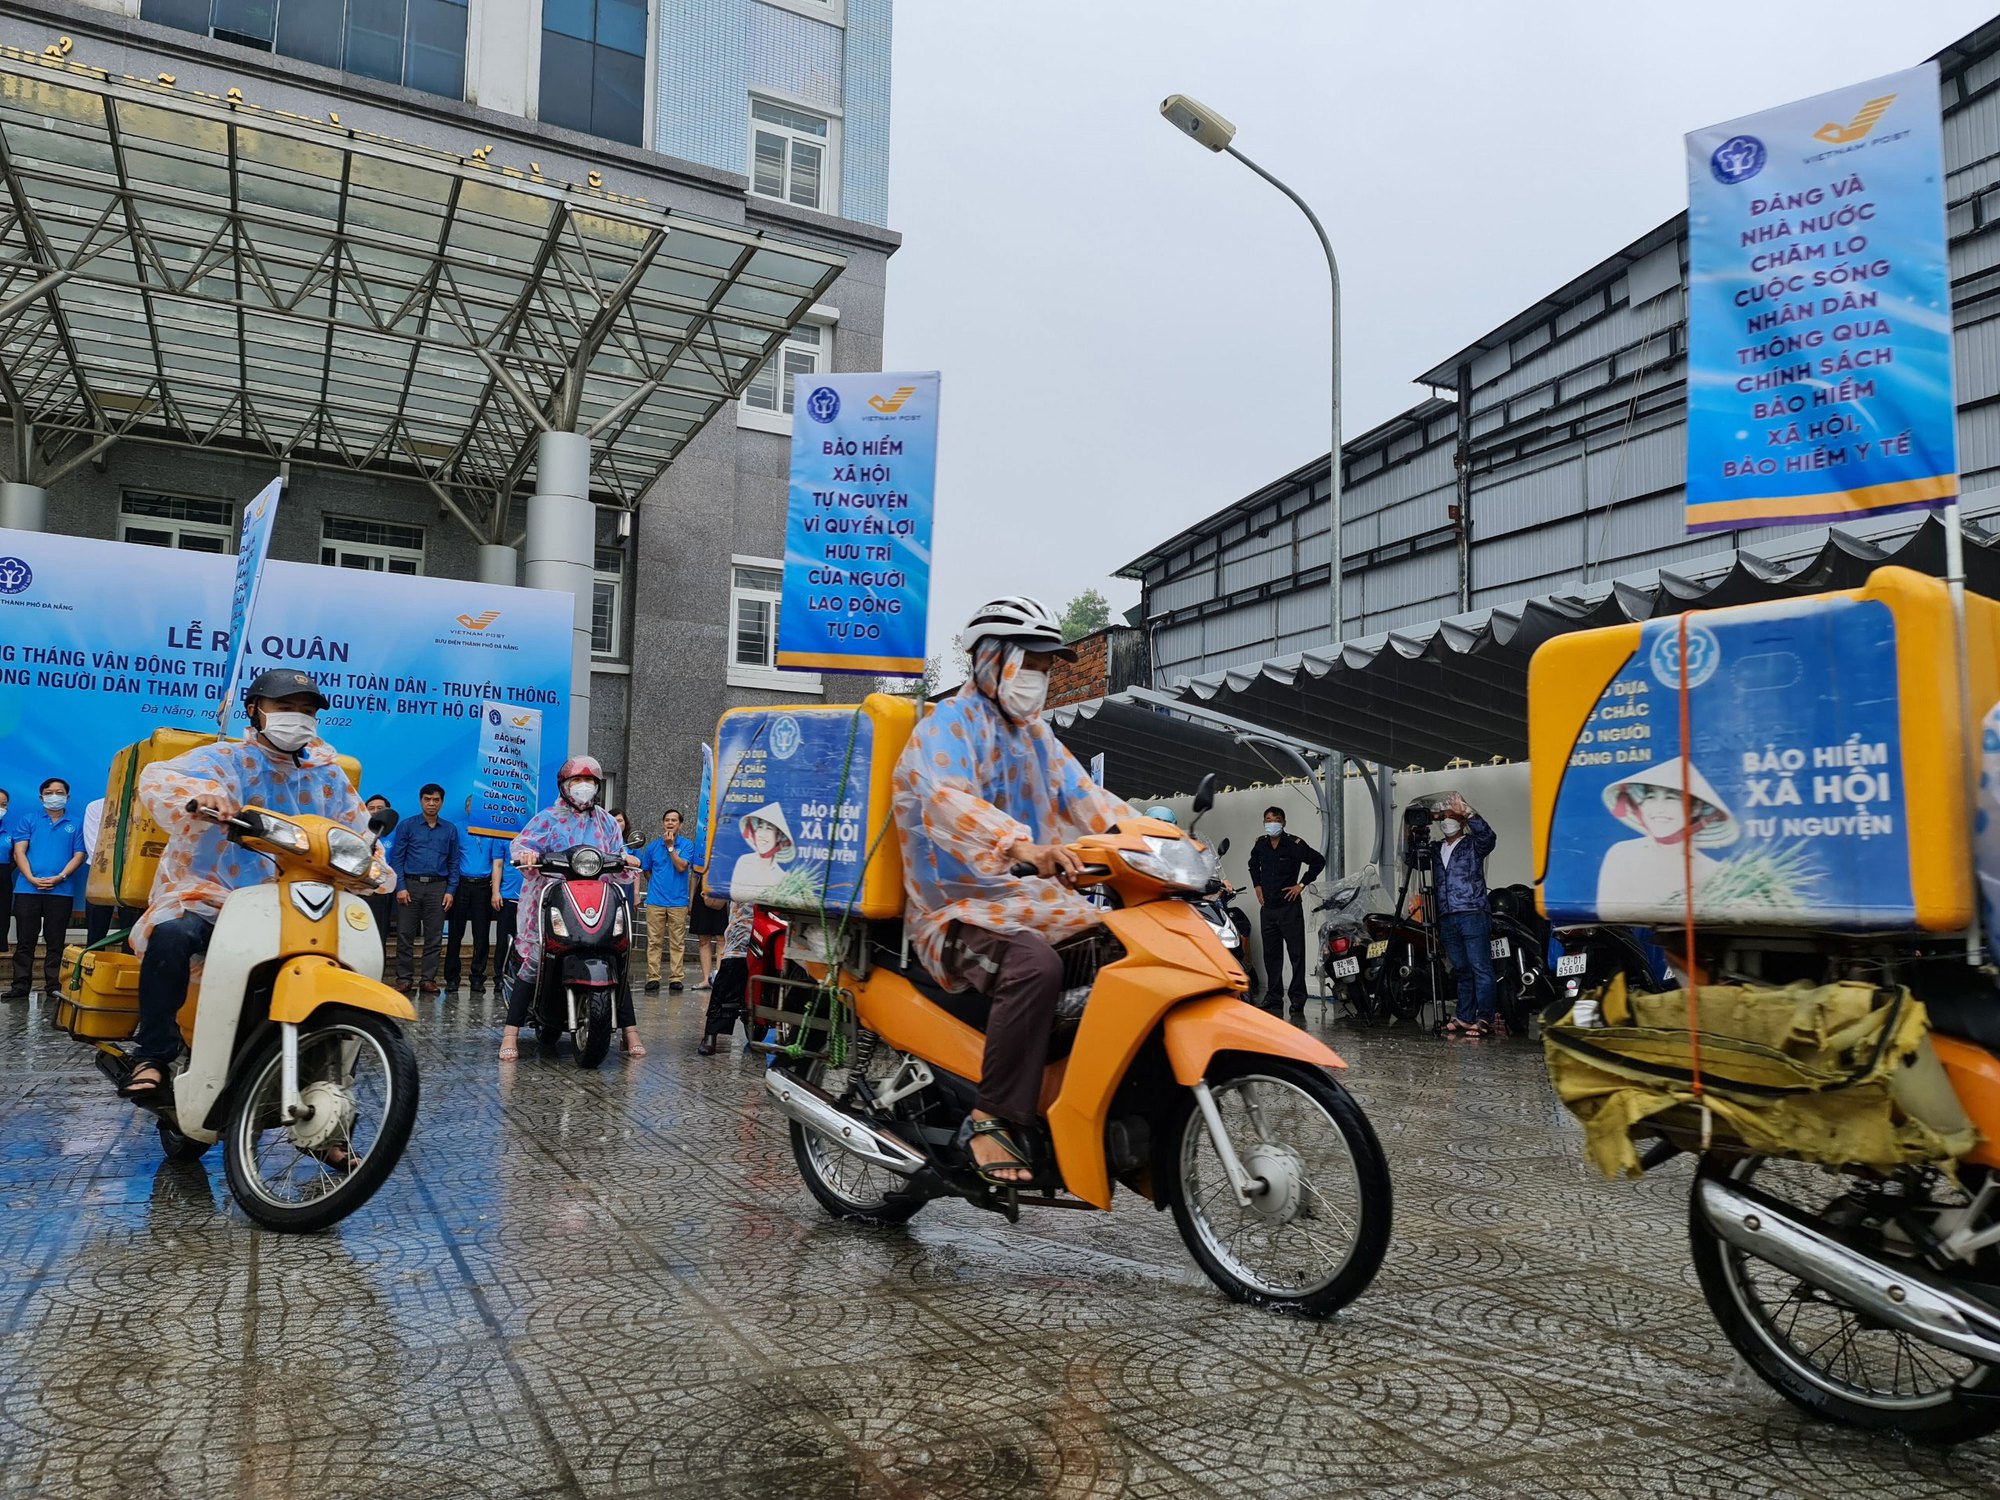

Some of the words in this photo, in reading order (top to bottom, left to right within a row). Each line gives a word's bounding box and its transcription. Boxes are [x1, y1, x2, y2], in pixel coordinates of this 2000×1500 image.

[1750, 187, 1824, 217] ĐẢNG
[1830, 173, 1866, 199] VÀ
[1740, 216, 1793, 248] NHÀ
[1799, 202, 1877, 234] NƯỚC
[1751, 241, 1826, 273] CHĂM
[1835, 235, 1868, 258] LO
[1734, 275, 1805, 308] CUỘC
[1813, 258, 1890, 289] SỐNG
[1747, 299, 1814, 334] NHÂN
[1822, 289, 1878, 315] DÂN
[1737, 330, 1825, 366] THÔNG
[1832, 318, 1890, 343] QUA
[1735, 361, 1811, 394] CHÍNH
[1819, 346, 1892, 375] SÁCH
[1753, 393, 1805, 420] BẢO
[1813, 374, 1874, 408] HIỂM
[1767, 424, 1801, 447] XÃ
[1808, 412, 1862, 441] HỘI,
[822, 437, 857, 456] BẢO
[863, 434, 903, 456] HIỂM
[1722, 453, 1777, 478] BẢO
[1784, 439, 1847, 473] HIỂM
[1855, 441, 1871, 461] Y
[1878, 429, 1912, 457] TẾ
[833, 464, 856, 482] XÃ
[861, 464, 890, 486] HỘI
[813, 492, 835, 511] TỰ
[838, 490, 908, 512] NGUYỆN
[803, 514, 820, 533] VÌ
[824, 517, 883, 535] QUYỀN
[887, 519, 914, 538] LỢI
[825, 544, 860, 560] HƯU
[865, 543, 891, 561] TRÍ
[808, 565, 843, 586] CỦA
[849, 569, 905, 588] NGƯỜI
[53, 603, 73, 611] NẴNG
[808, 596, 842, 612] LAO
[848, 594, 902, 617] ĐỘNG
[168, 620, 203, 650] LỄ
[261, 635, 350, 663] QUÂN
[450, 629, 483, 637] VIETNAM
[827, 622, 850, 640] TỰ
[853, 624, 880, 639] DO
[0, 645, 16, 661] G
[22, 645, 86, 667] THÁNG
[92, 650, 129, 673] VẬN
[134, 654, 186, 677] ĐỘNG
[192, 660, 243, 680] TRI
[307, 671, 341, 687] HXH
[346, 672, 389, 691] TOÀN
[395, 676, 427, 694] DÂN
[442, 680, 502, 700] TRUYỀN
[507, 686, 561, 707] THÔNG,
[0, 668, 30, 686] NG
[38, 671, 96, 691] NGƯỜI
[103, 674, 140, 694] DÂN
[147, 679, 198, 698] THAM
[205, 684, 222, 700] GI
[397, 699, 438, 716] BHYT
[442, 700, 464, 720] HỘ
[469, 704, 483, 719] GI
[1614, 680, 1649, 697] DỰA
[141, 703, 158, 714] Đà
[161, 704, 197, 718] Nẵng,
[325, 716, 352, 727] 2022
[1601, 698, 1650, 720] CHẮC
[494, 732, 509, 742] BẢO
[1597, 723, 1651, 742] NGƯỜI
[1616, 745, 1652, 763] DÂN
[1742, 743, 1806, 773] BẢO
[1813, 732, 1888, 768] HIỂM
[483, 766, 491, 775] VÌ
[484, 789, 500, 799] CỦA
[1745, 771, 1803, 807] XÃ
[1813, 766, 1891, 811] HỘI
[484, 803, 499, 811] LAO
[801, 799, 828, 818] BẢO
[503, 817, 516, 825] DO
[799, 818, 824, 840] XÃ
[828, 819, 859, 846] HỘI
[1745, 816, 1777, 842] TỰ
[1782, 810, 1893, 840] NGUYỆN
[798, 846, 812, 862] TỰ
[812, 845, 857, 865] NGUYỆN
[1558, 964, 1585, 975] 956.06
